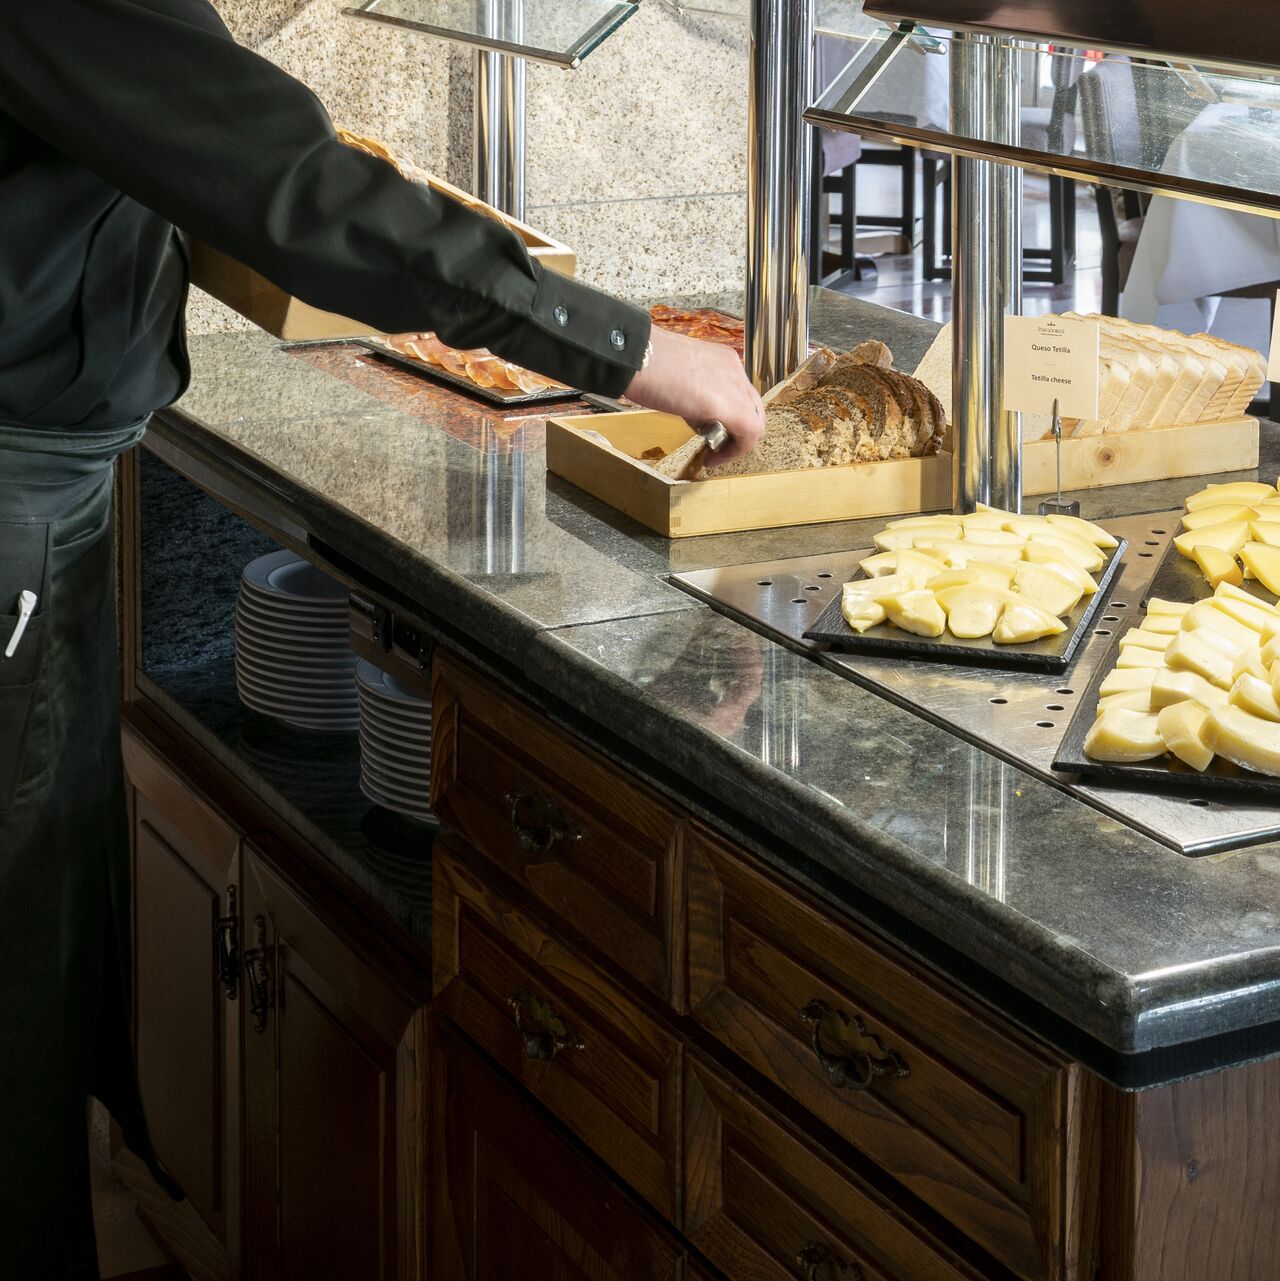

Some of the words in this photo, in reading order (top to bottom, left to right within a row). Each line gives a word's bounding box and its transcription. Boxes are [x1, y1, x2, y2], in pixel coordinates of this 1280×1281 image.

[1031, 344, 1051, 352] Queso
[1052, 346, 1071, 354] Tetilla
[1031, 374, 1050, 382] Tetilla
[1050, 376, 1072, 385] cheese
